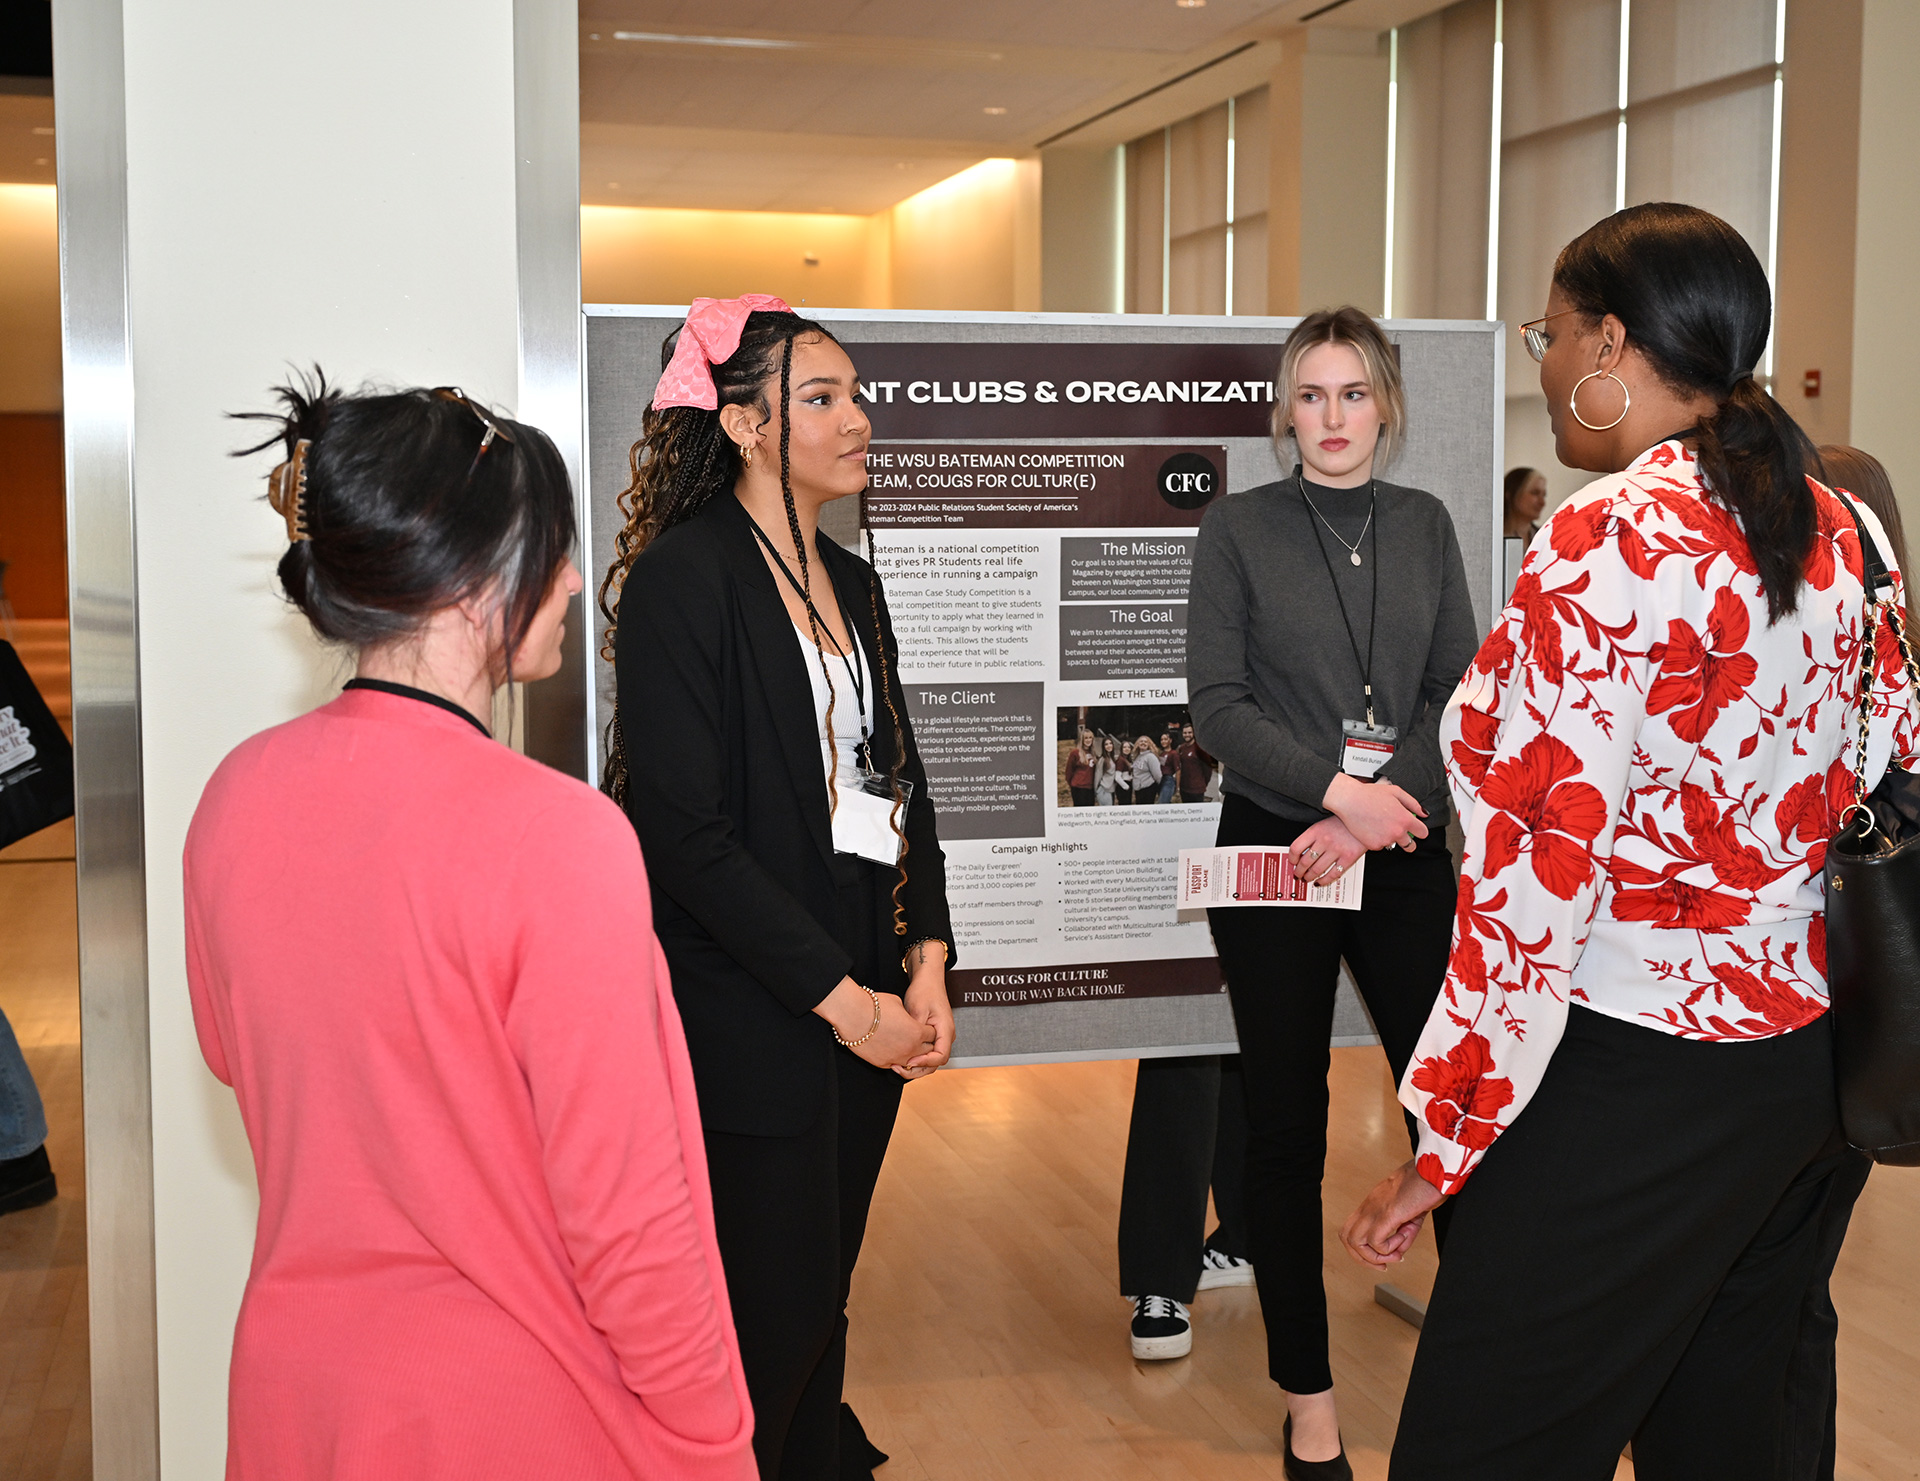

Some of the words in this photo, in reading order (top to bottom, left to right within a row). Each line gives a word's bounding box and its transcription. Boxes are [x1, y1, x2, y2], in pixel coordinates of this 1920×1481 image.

[907, 381, 1027, 403] CLUBS
[1034, 381, 1059, 403] &
[1065, 381, 1276, 402] ORGANIZATI
[897, 454, 935, 467] WSU
[939, 454, 1015, 467] BATEMAN
[1019, 454, 1124, 467] COMPETITION
[916, 474, 973, 488] COUGS
[977, 474, 1007, 488] FOR
[1011, 474, 1096, 490] CULTUR(E)
[1166, 473, 1210, 492] CFC
[868, 503, 878, 511] he
[879, 503, 916, 511] 2023-2024
[918, 503, 940, 511] Public
[942, 503, 975, 511] Relations
[976, 503, 1005, 511] Student
[1006, 503, 1033, 513] Society
[1033, 503, 1042, 511] of
[1043, 503, 1078, 511] America's
[897, 515, 942, 524] Competition
[918, 545, 926, 553] is
[937, 544, 977, 553] national
[980, 544, 1039, 555] competition
[1101, 543, 1128, 556] The
[1132, 542, 1185, 555] Mission
[877, 557, 892, 566] hat
[895, 558, 920, 568] gives
[923, 557, 936, 566] PR
[938, 557, 982, 566] Students
[985, 556, 1004, 566] real
[1007, 556, 1023, 565] life
[1085, 558, 1100, 568] goal
[1116, 558, 1135, 566] share
[1171, 557, 1179, 565] of
[879, 570, 928, 581] xperience
[931, 570, 940, 578] in
[943, 570, 981, 581] running
[992, 570, 1038, 580] campaign
[1072, 568, 1104, 578] Magazine
[1105, 568, 1114, 577] by
[1114, 568, 1145, 577] engaging
[1072, 578, 1101, 586] between
[1112, 578, 1152, 587] Washington
[1152, 577, 1170, 585] State
[888, 589, 923, 597] Bateman
[925, 588, 944, 596] Case
[945, 588, 967, 598] Study
[969, 588, 1016, 598] Competition
[1018, 588, 1025, 596] is
[1128, 588, 1166, 596] community
[905, 601, 953, 610] competition
[954, 600, 979, 608] meant
[981, 600, 990, 608] to
[992, 600, 1008, 610] give
[1010, 599, 1042, 608] students
[942, 612, 963, 622] apply
[965, 612, 984, 620] what
[986, 612, 1004, 621] they
[1109, 610, 1136, 623] The
[1140, 609, 1173, 622] Goal
[933, 625, 970, 634] campaign
[972, 624, 982, 634] by
[983, 624, 1014, 633] working
[936, 636, 953, 644] This
[954, 636, 979, 644] allows
[981, 636, 994, 644] the
[920, 649, 963, 658] experience
[965, 648, 981, 656] that
[927, 660, 946, 668] their
[948, 660, 972, 668] future
[974, 660, 982, 668] in
[984, 659, 1007, 669] public
[1009, 659, 1045, 667] relations.
[919, 692, 947, 705] The
[951, 691, 996, 704] Client
[1099, 690, 1124, 699] MEET
[1127, 690, 1146, 698] THE
[1149, 689, 1177, 698] TEAM!
[929, 716, 951, 726] global
[952, 715, 980, 725] lifestyle
[981, 714, 1009, 722] network
[1010, 714, 1025, 722] that
[914, 726, 922, 734] 17
[954, 725, 989, 733] countries.
[990, 724, 1004, 732] The
[1004, 726, 1036, 734] company
[991, 845, 1038, 855] Campaign
[1041, 843, 1088, 854] Highlights
[1082, 859, 1105, 868] people
[1084, 868, 1115, 877] Compton
[1136, 866, 1164, 875] Building.
[1191, 864, 1202, 894] PASSPORT
[982, 975, 1025, 985] COUGS
[1027, 973, 1051, 983] FOR
[1053, 969, 1108, 981] CULTURE
[964, 992, 993, 1002] FIND
[995, 991, 1027, 1001] YOUR
[1029, 988, 1055, 998] WAY
[1057, 986, 1087, 997] BACK
[1090, 984, 1125, 995] HOME
